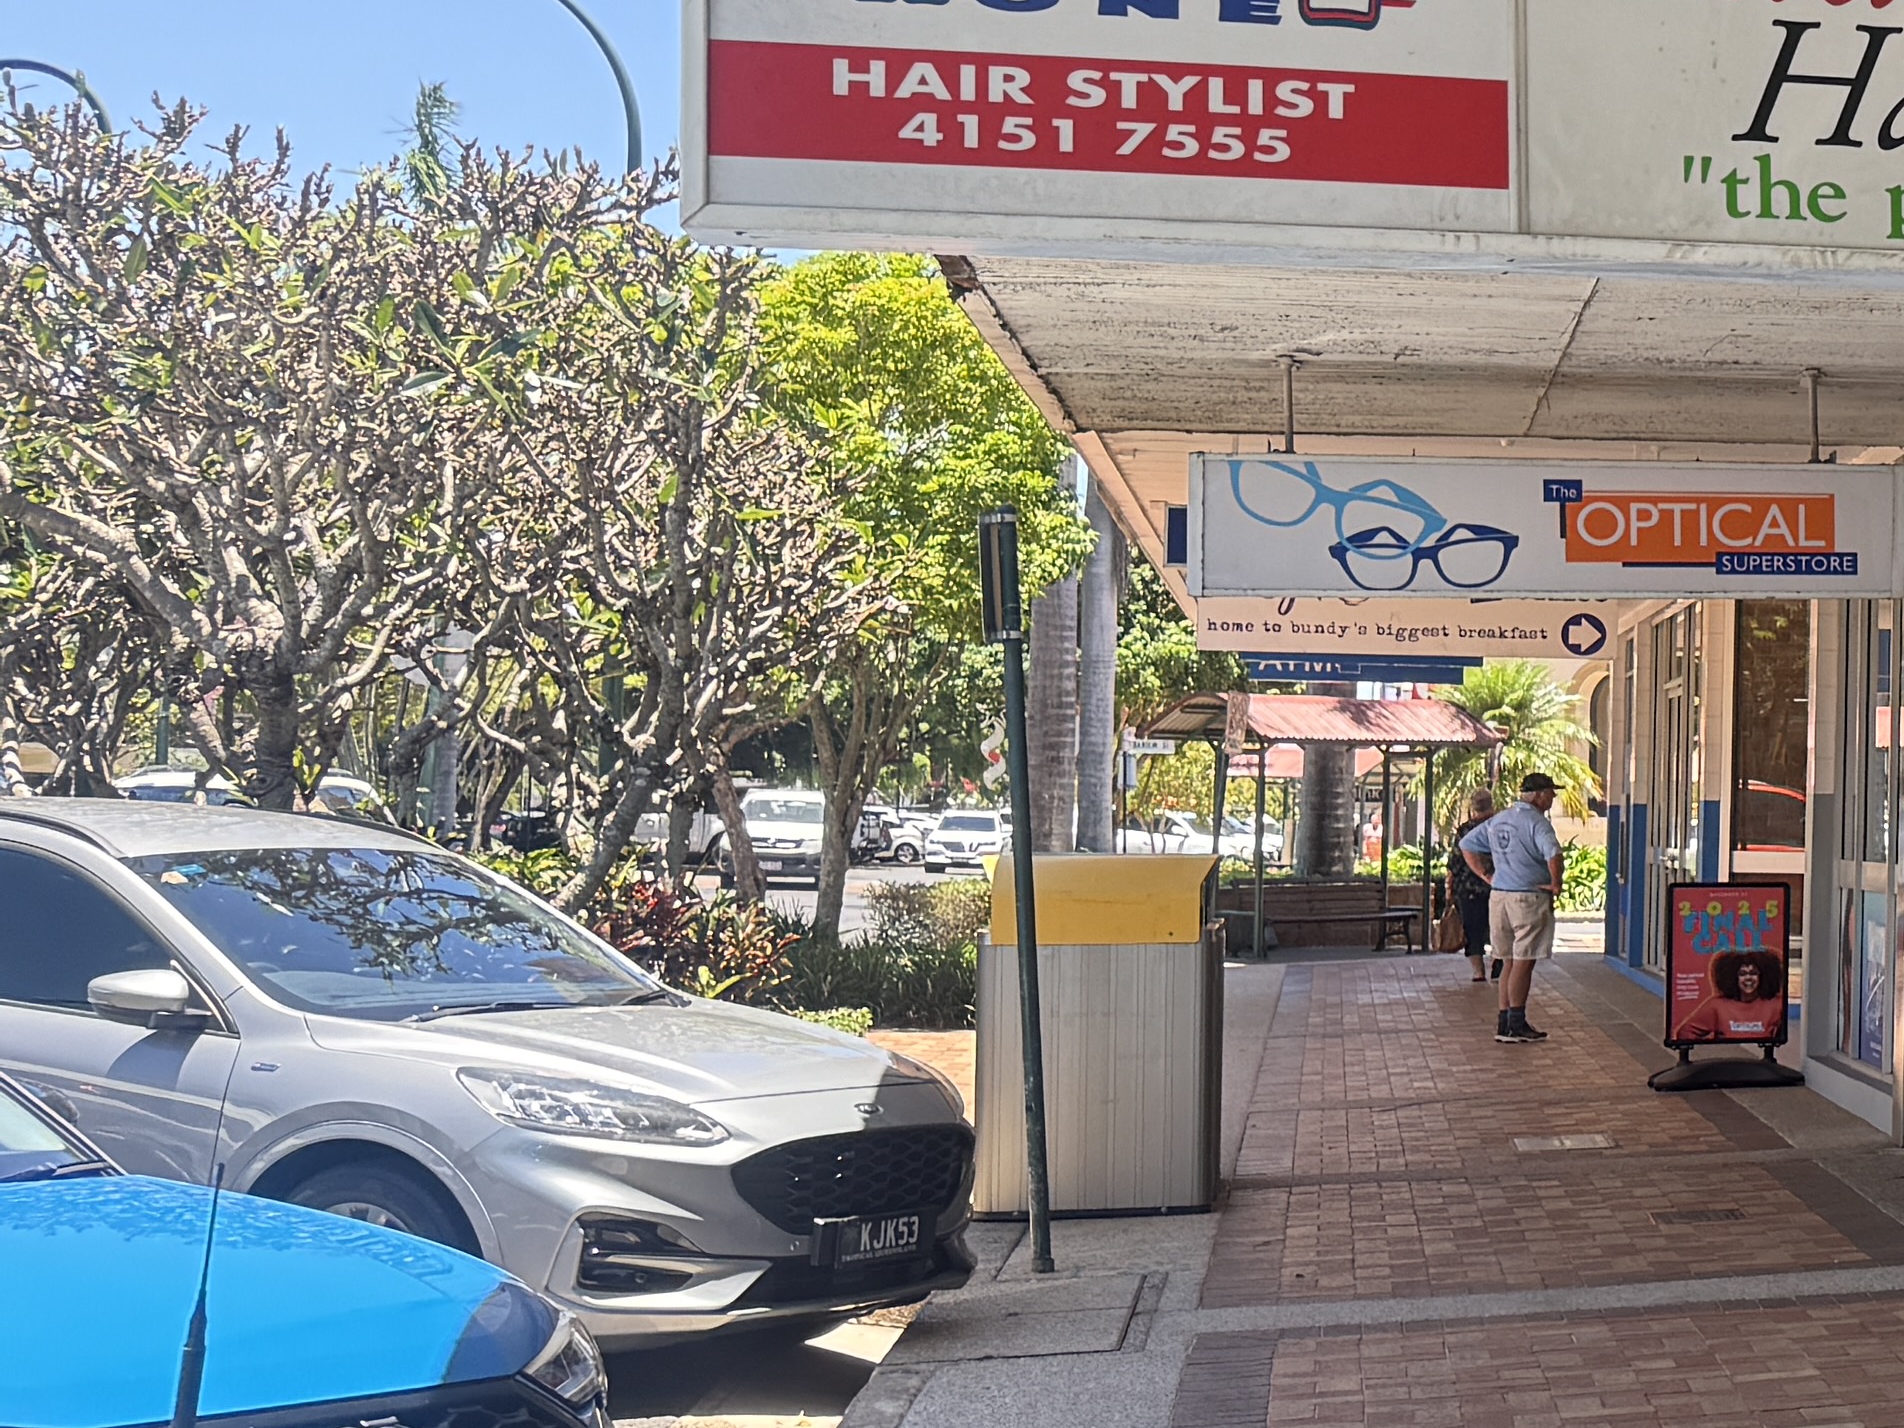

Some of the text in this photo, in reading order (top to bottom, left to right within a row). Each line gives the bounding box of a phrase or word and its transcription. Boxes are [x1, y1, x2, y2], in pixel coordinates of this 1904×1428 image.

[831, 56, 1356, 124] HAIR STYLIST
[895, 104, 1294, 167] 4151 7555
[1680, 152, 1850, 233] "the
[1547, 483, 1579, 500] The
[1576, 502, 1827, 549] OPTICAL
[1720, 554, 1857, 573] SUPERSTORE
[1206, 618, 1548, 644] home to bundy's biggest breakfast
[1682, 908, 1773, 934] FINAL
[1692, 930, 1767, 955] CALL
[859, 1215, 919, 1252] KJK53
